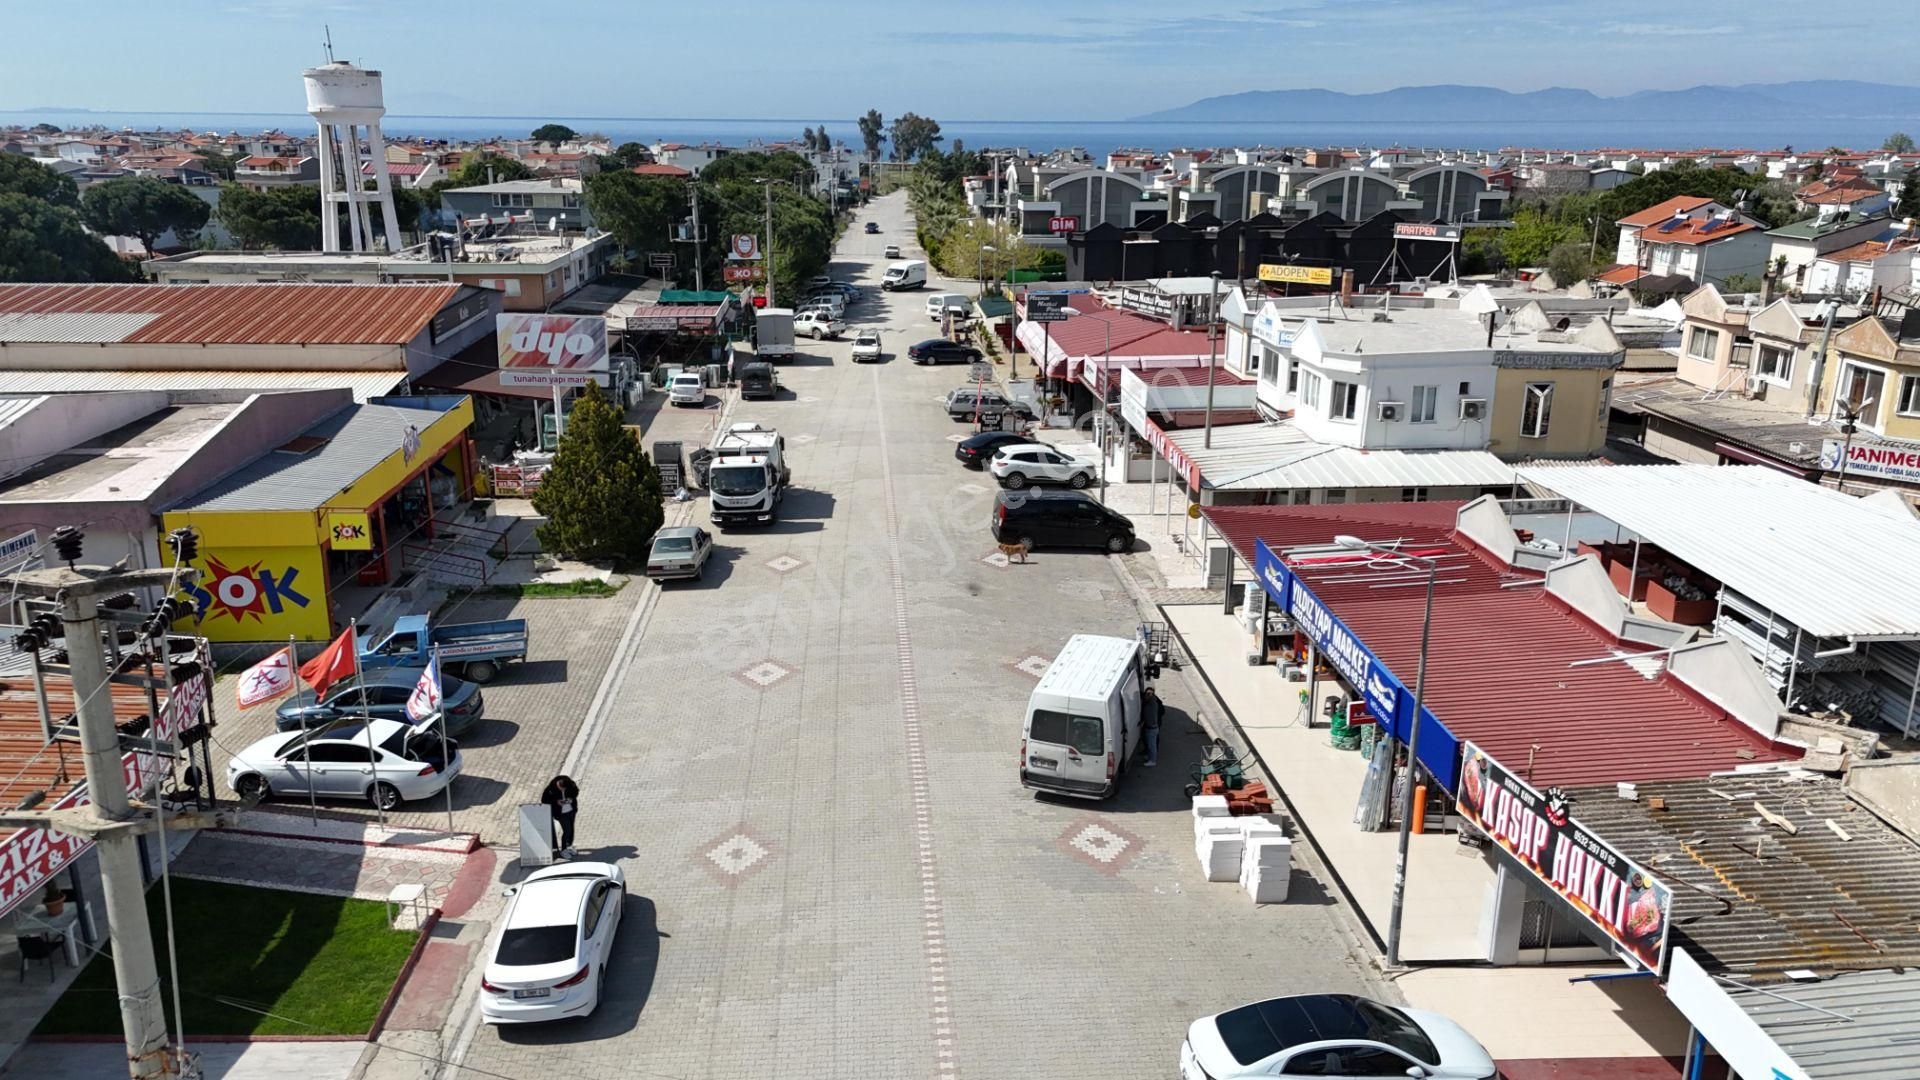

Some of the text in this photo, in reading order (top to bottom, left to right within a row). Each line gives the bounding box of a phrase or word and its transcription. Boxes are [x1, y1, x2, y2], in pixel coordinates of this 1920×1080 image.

[1396, 225, 1437, 236] FIRATPEN
[1270, 266, 1310, 278] ADOPEN
[511, 320, 595, 365] dyo
[1515, 356, 1553, 366] CEPHE
[1554, 356, 1608, 366] KAPLAMA
[549, 376, 566, 385] yapı
[1885, 468, 1904, 476] ÇORBA
[1905, 470, 1920, 478] SALO
[332, 524, 366, 541] ŞOK
[1292, 580, 1371, 679] YILDIZ YAPI MARKET
[48, 849, 65, 870] &
[1482, 778, 1631, 934] KASAP HAKKI
